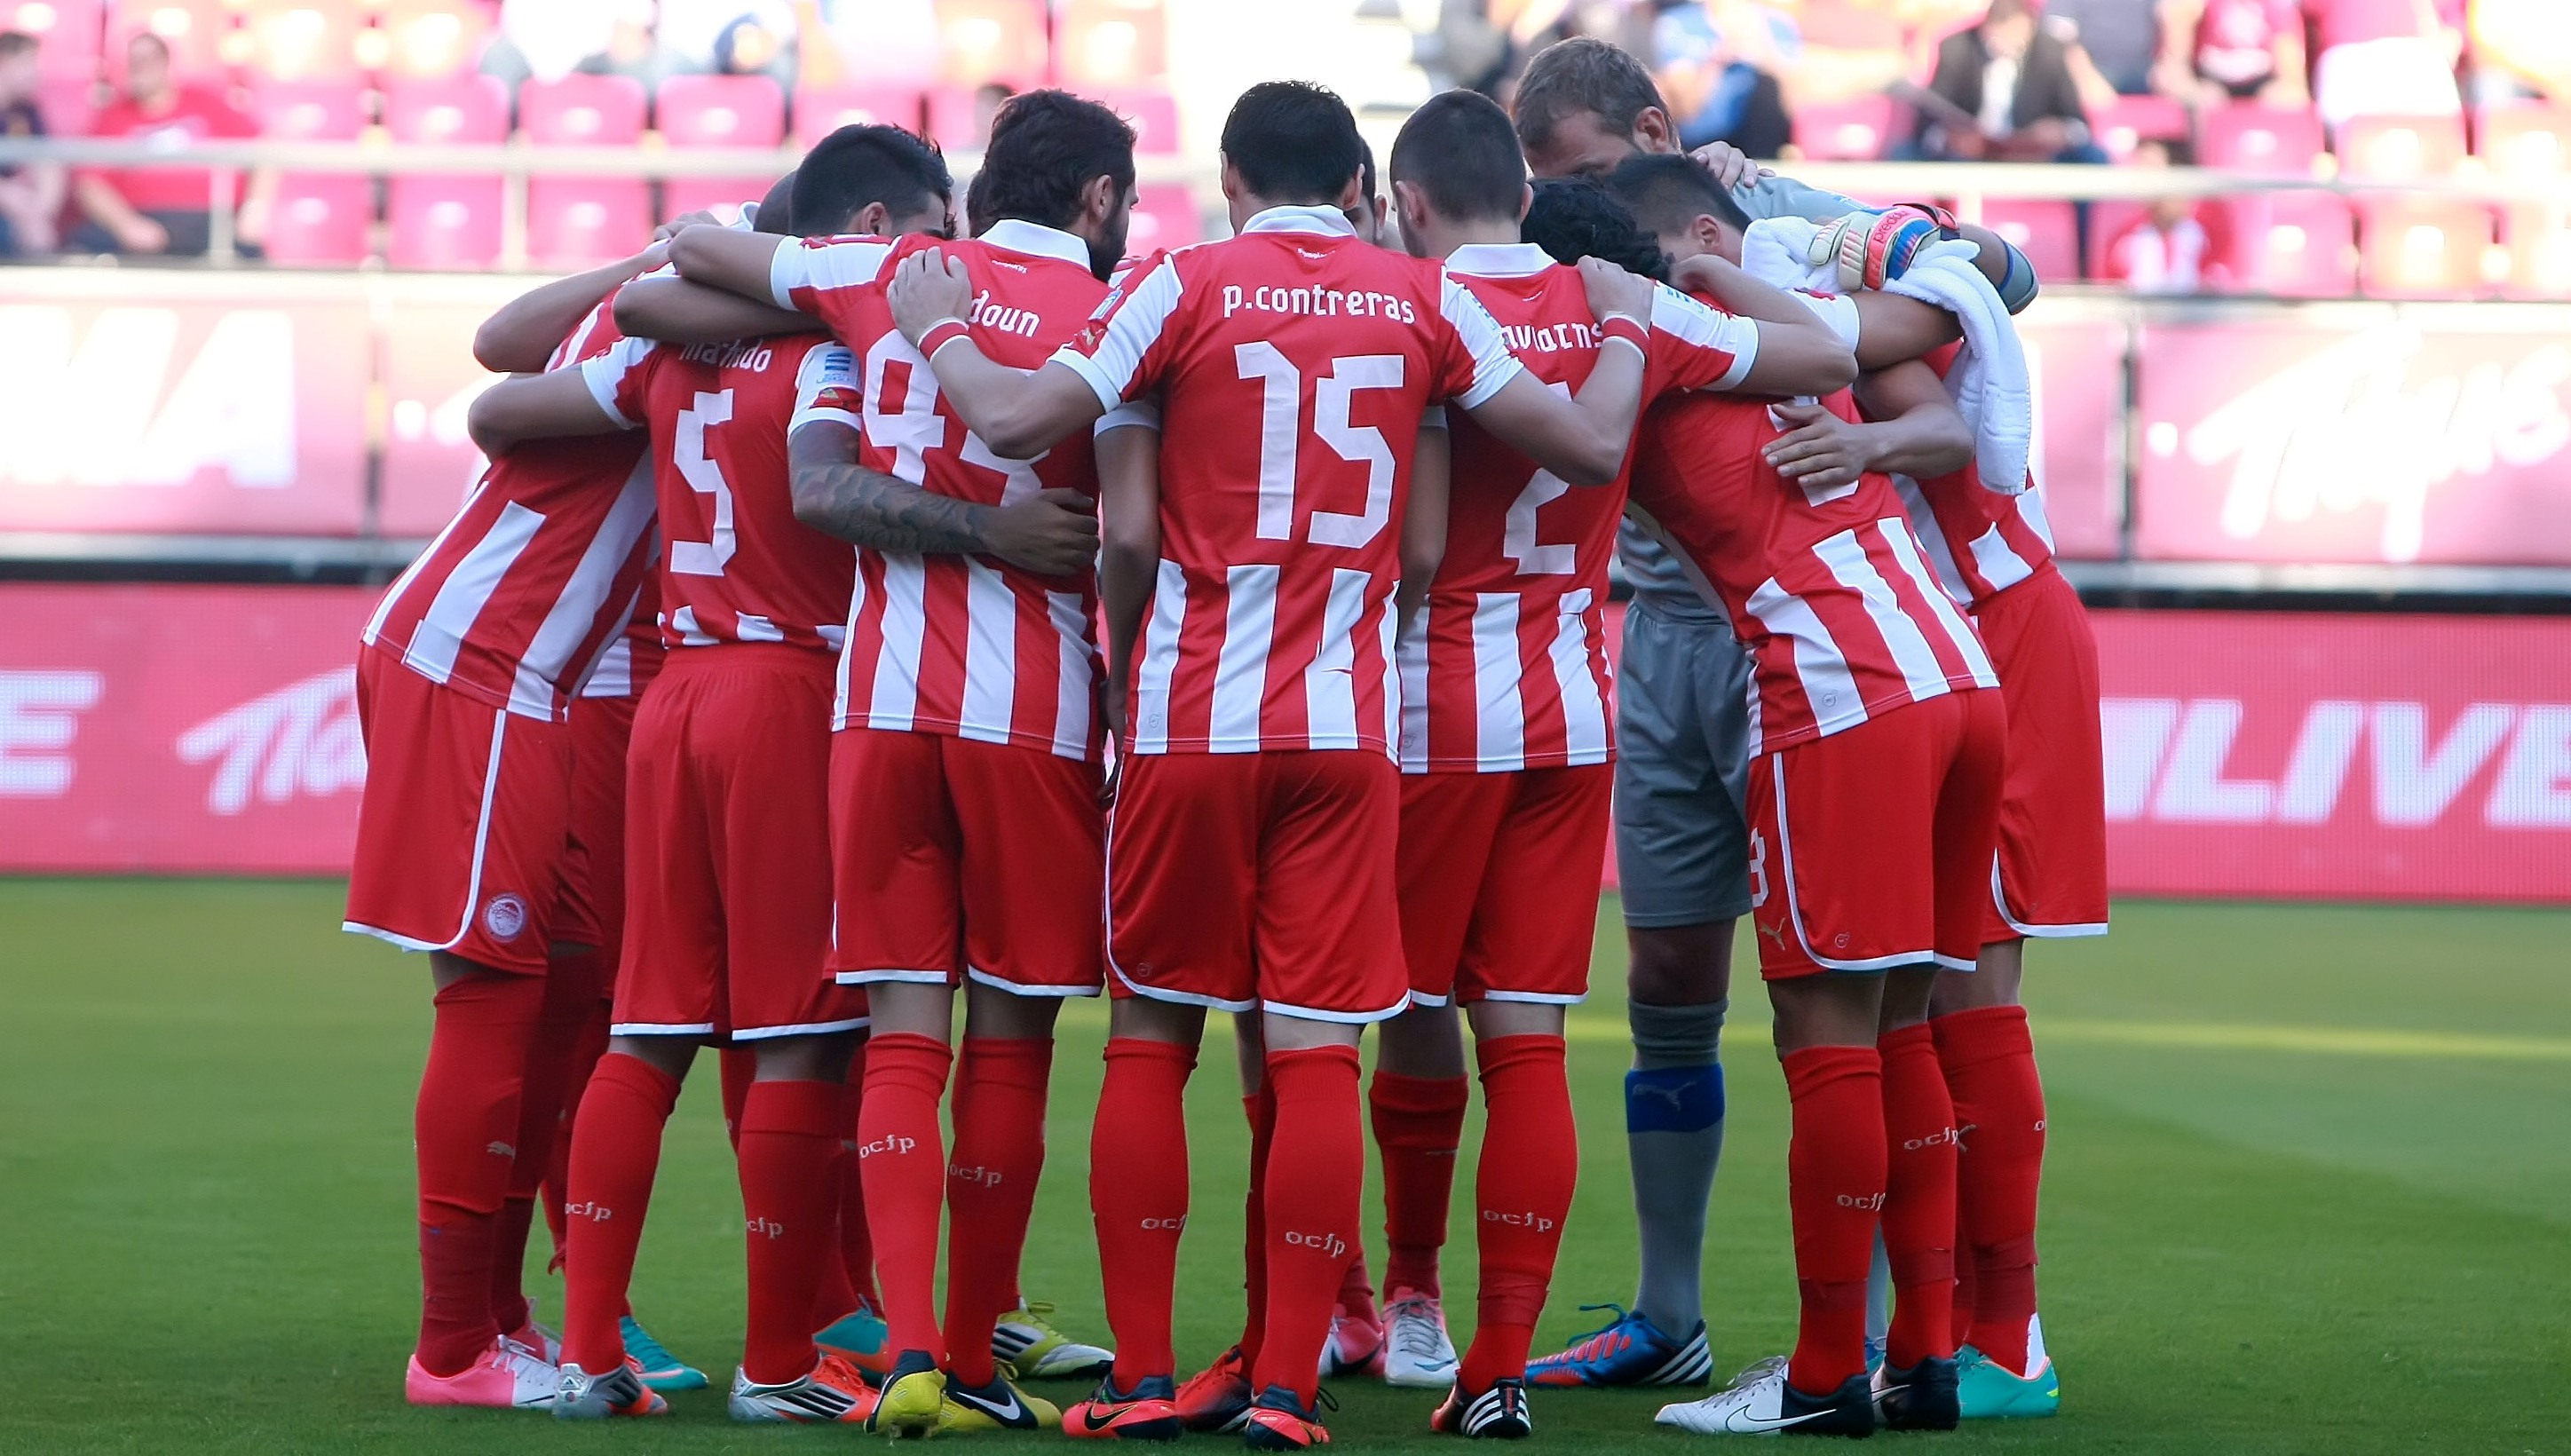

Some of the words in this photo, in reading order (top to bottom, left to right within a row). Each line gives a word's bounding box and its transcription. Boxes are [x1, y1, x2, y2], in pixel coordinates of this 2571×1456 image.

[1222, 283, 1416, 325] p.contreras
[1234, 340, 1404, 550] 15
[669, 388, 737, 577] 5
[859, 1134, 915, 1159] ocfp
[1483, 1210, 1553, 1233] ocfp
[1285, 1230, 1346, 1259] ocfp
